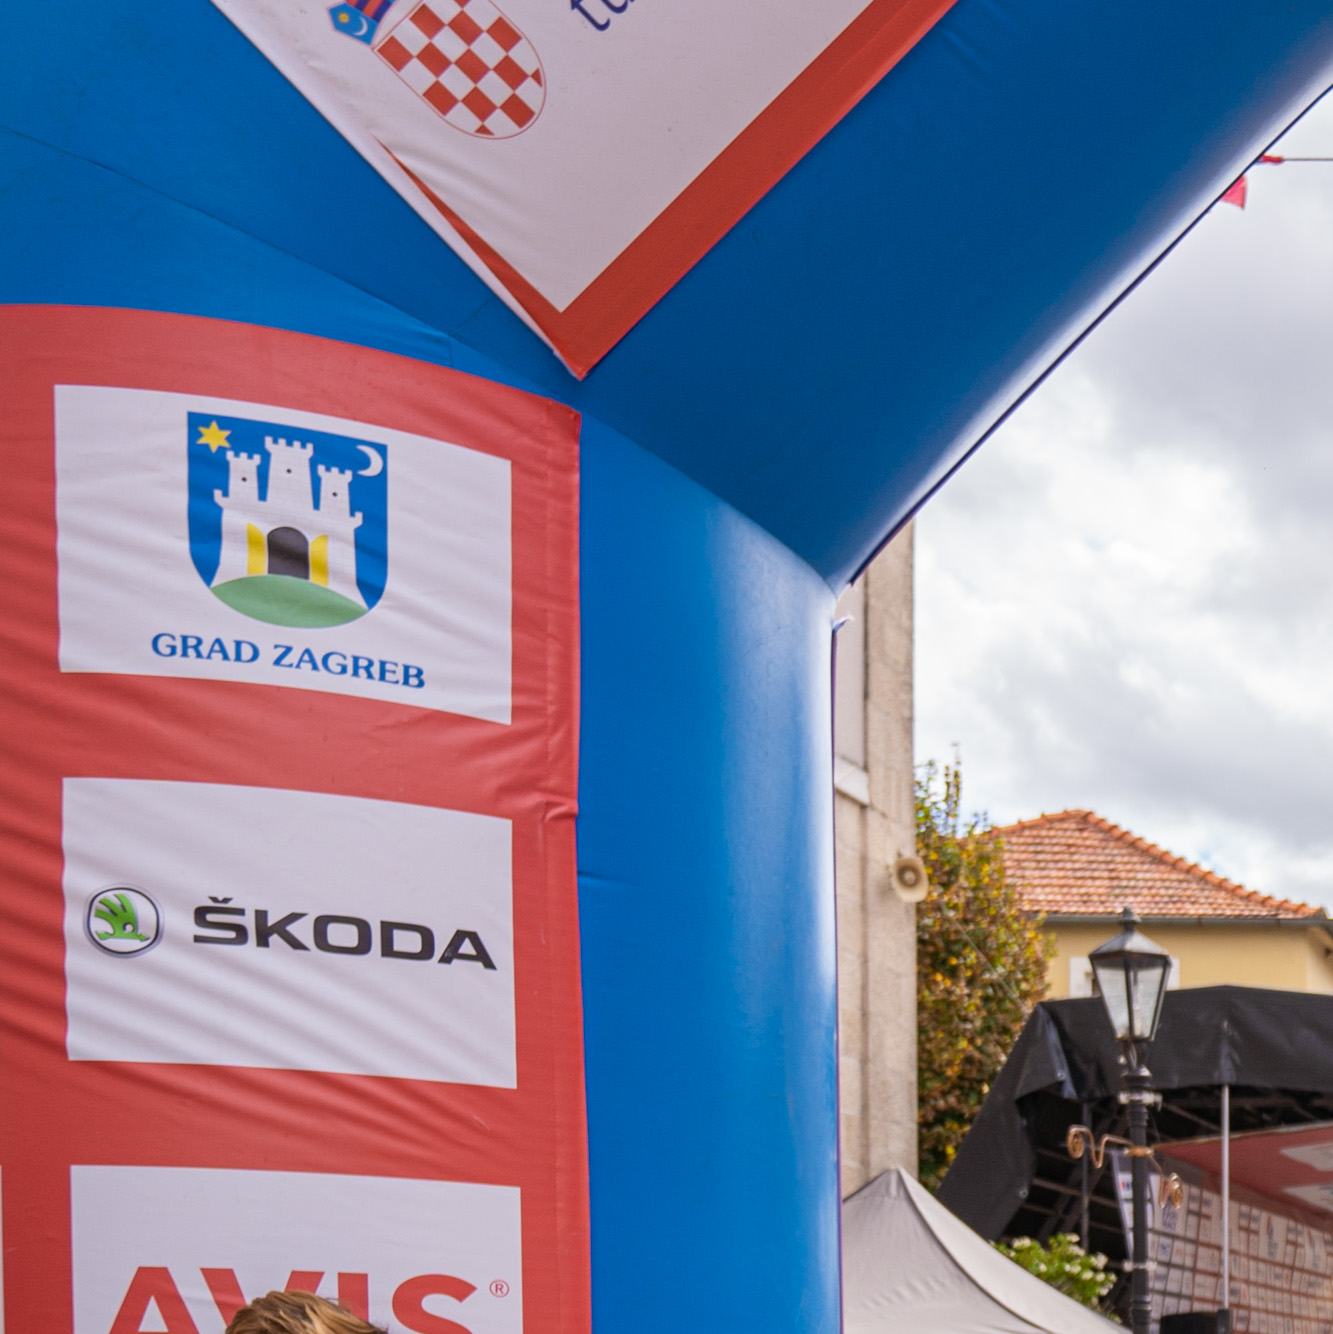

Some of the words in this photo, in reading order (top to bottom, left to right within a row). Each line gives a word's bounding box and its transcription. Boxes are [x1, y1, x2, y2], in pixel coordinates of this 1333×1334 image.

[151, 633, 260, 663] GRAD
[272, 644, 426, 690] ZAGREB
[193, 896, 498, 971] ŠKODA
